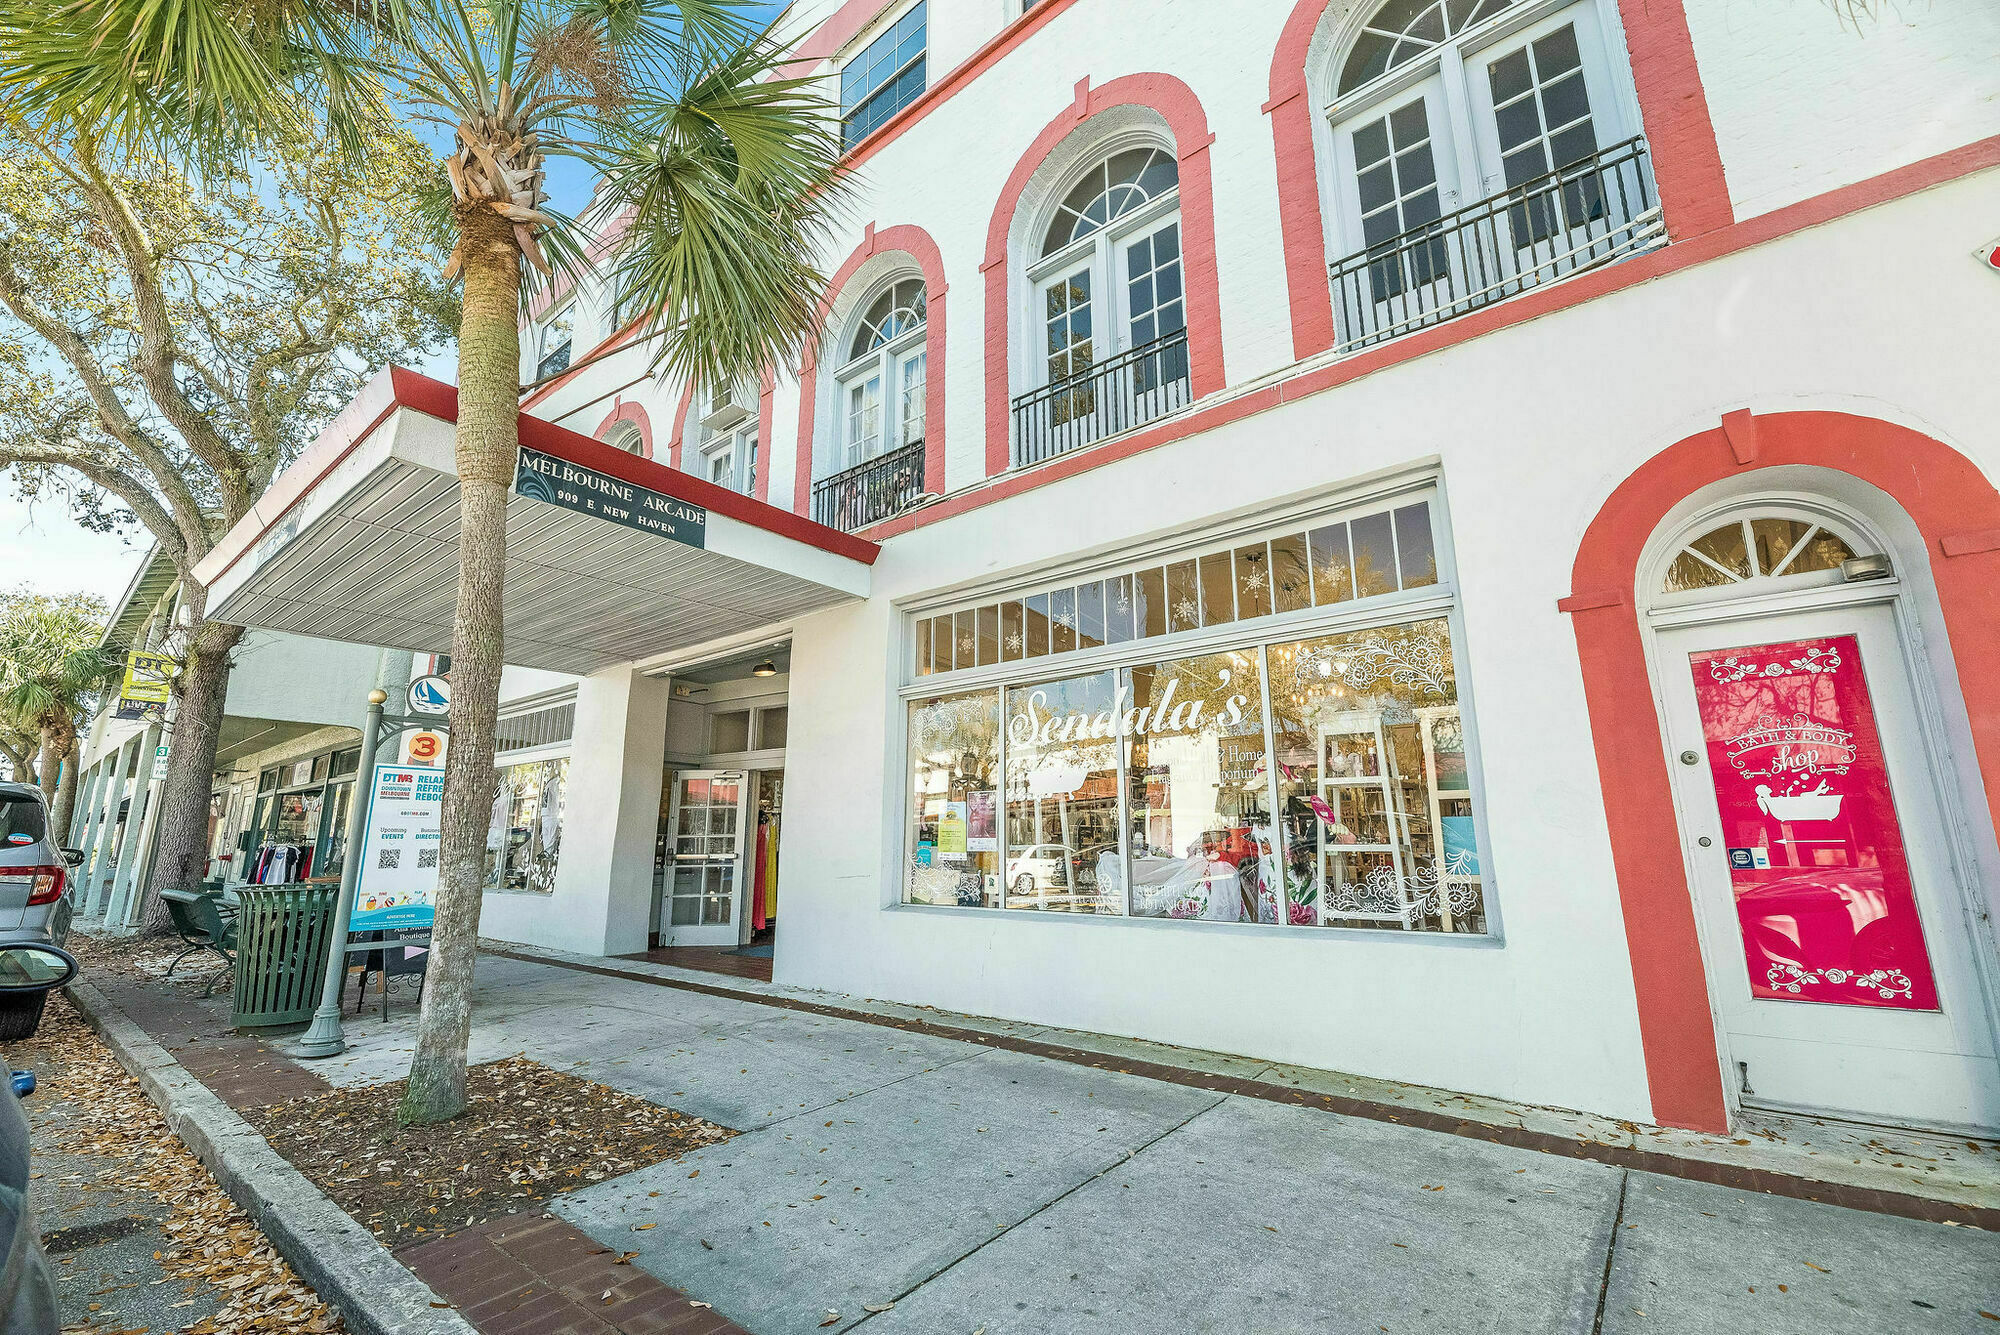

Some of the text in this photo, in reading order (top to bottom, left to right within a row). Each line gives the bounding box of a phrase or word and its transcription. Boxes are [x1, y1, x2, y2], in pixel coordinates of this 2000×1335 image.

[521, 452, 705, 526] MELBOURNE ARCADE
[557, 489, 578, 504] 909
[602, 504, 630, 520] NEW
[638, 515, 676, 535] HAVEN
[1008, 668, 1258, 748] Sendala's
[412, 736, 436, 757] 3
[1736, 730, 1849, 750] BATH & BODY
[1228, 745, 1263, 762] Home
[1770, 745, 1819, 774] shop
[417, 775, 445, 784] RELAX
[399, 932, 431, 940] Boutique
